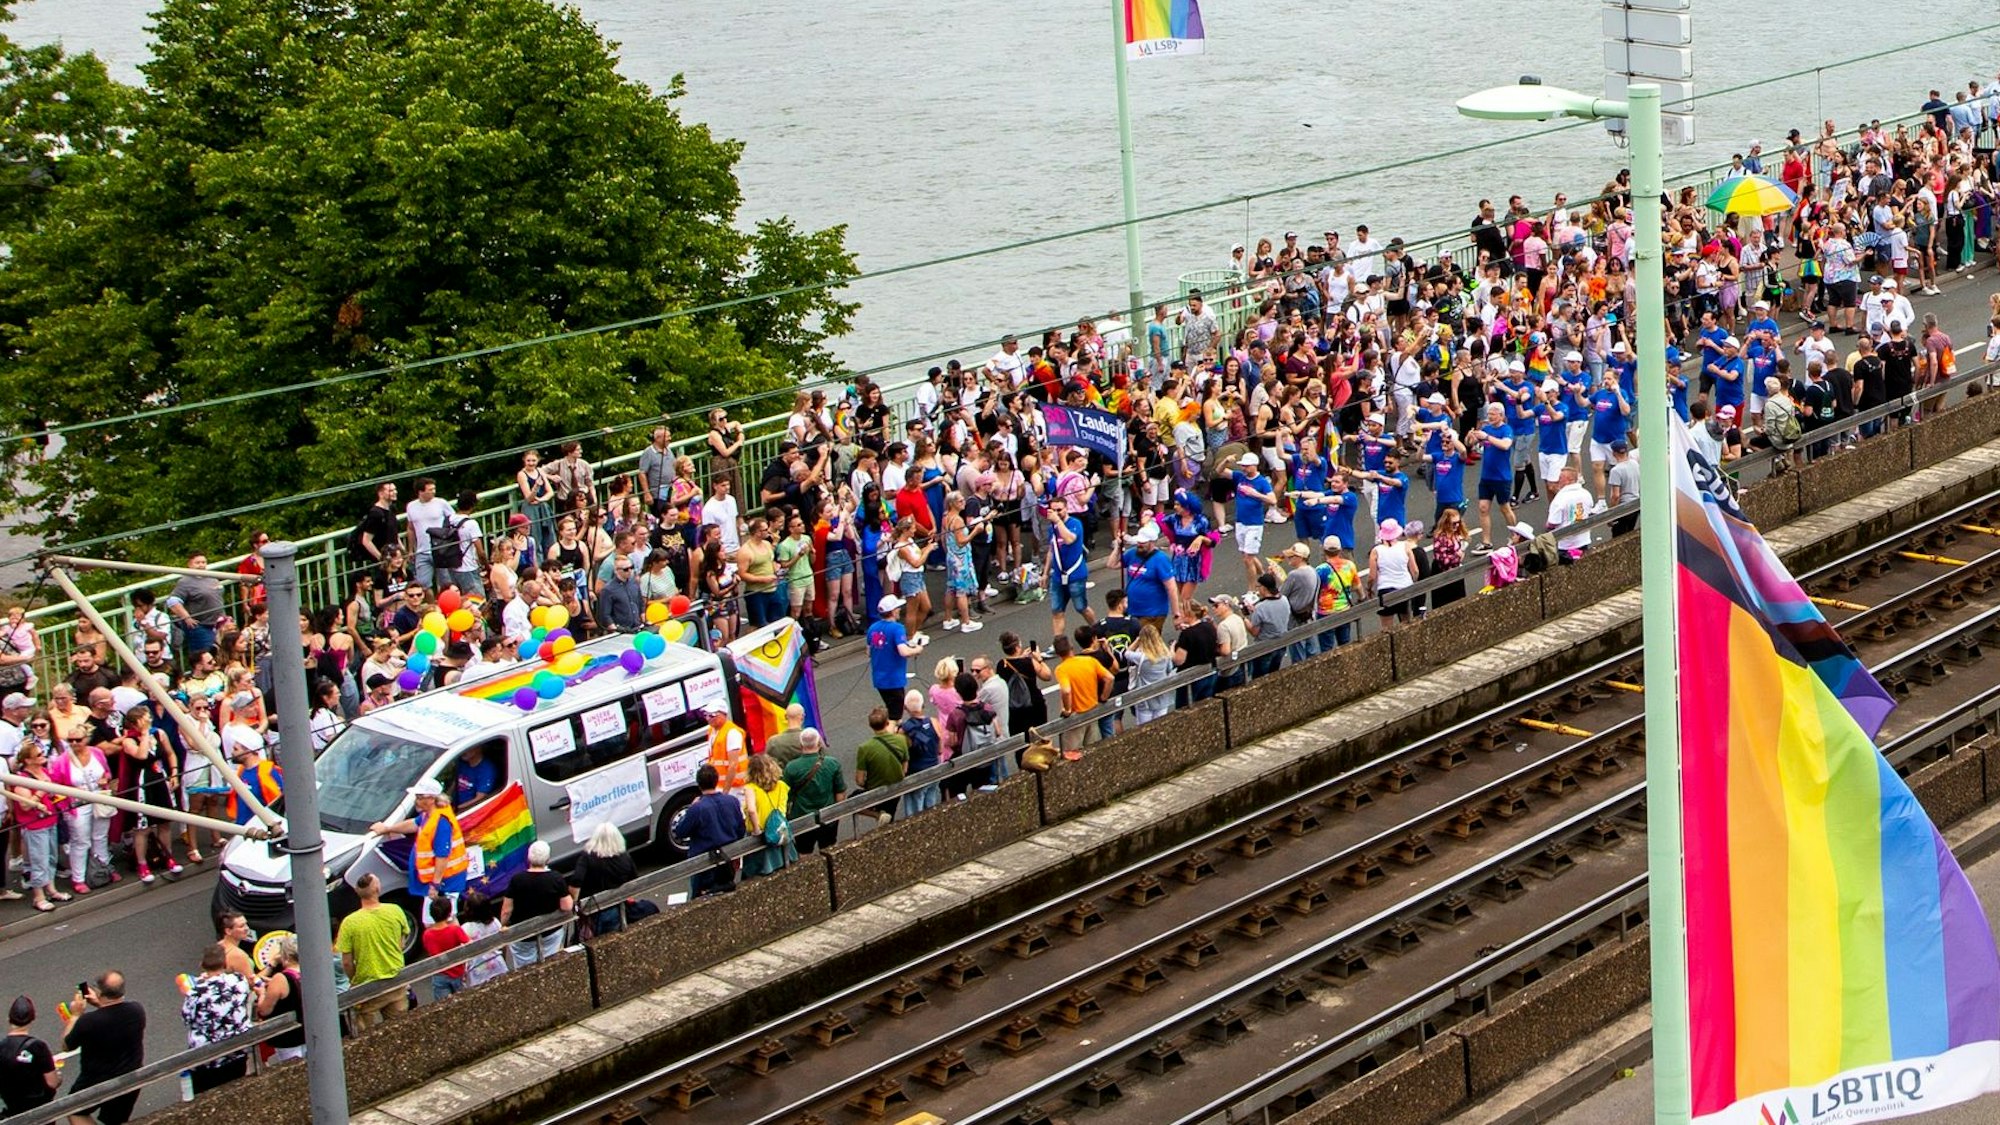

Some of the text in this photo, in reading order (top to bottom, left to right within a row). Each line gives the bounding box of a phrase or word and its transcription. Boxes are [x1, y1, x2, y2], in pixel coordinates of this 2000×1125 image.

[700, 677, 720, 689] Jahre
[535, 729, 552, 740] LAUT
[573, 780, 645, 815] Zauberflöten
[1845, 1101, 1906, 1117] Queerpolitik
